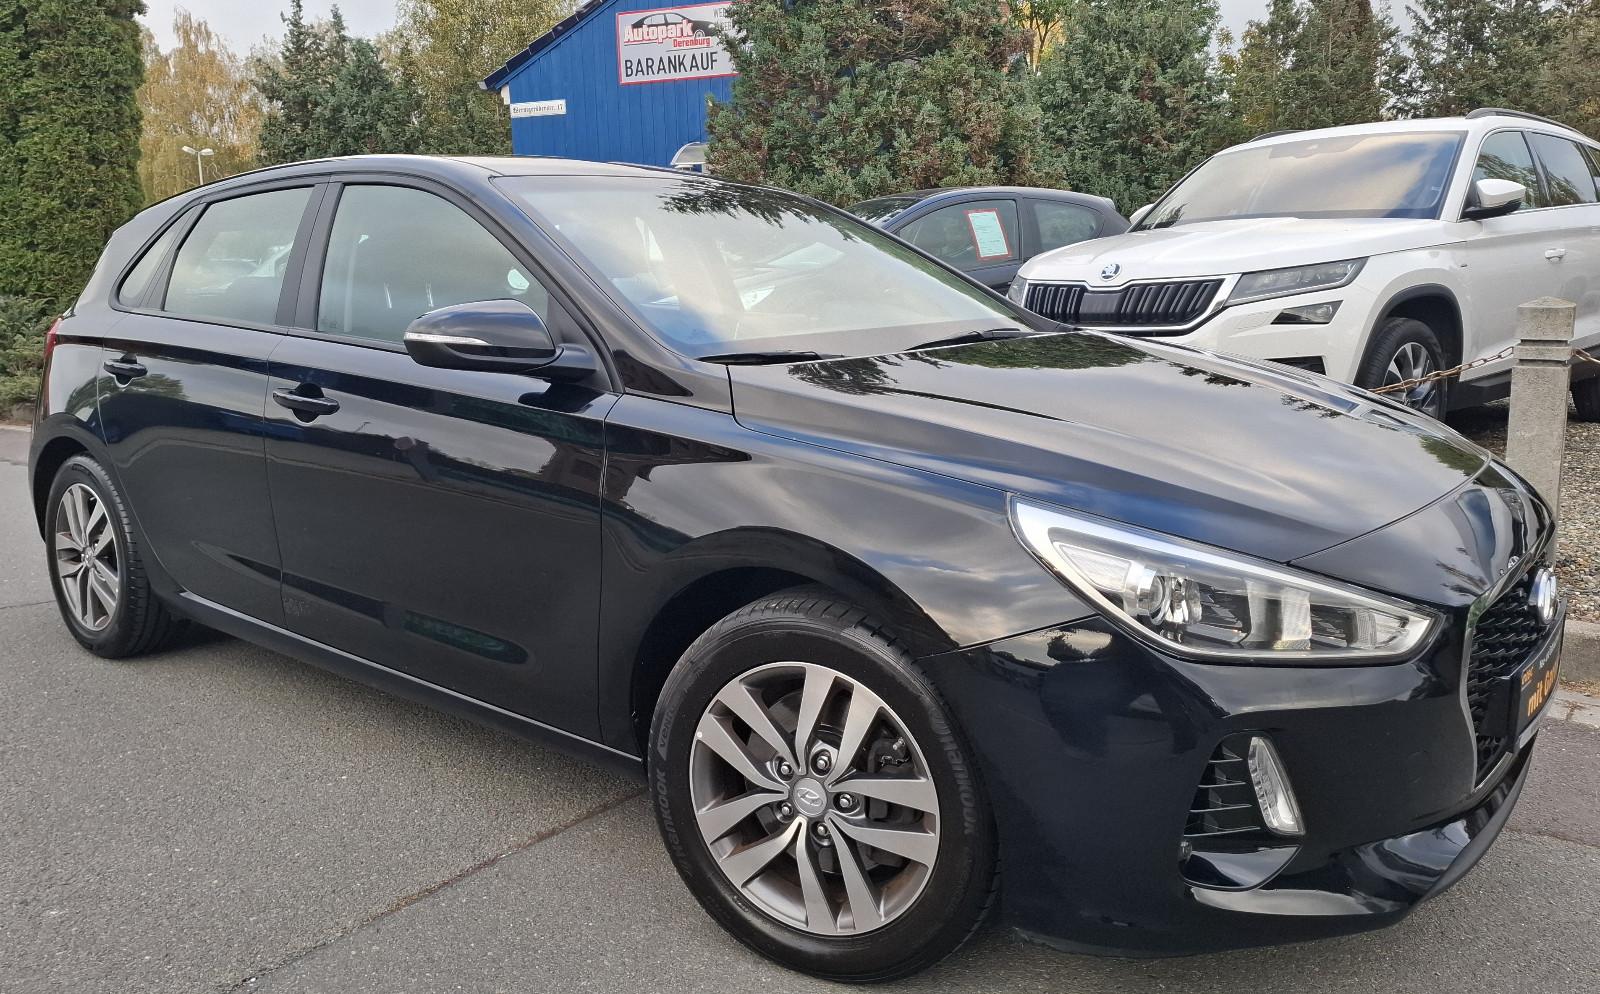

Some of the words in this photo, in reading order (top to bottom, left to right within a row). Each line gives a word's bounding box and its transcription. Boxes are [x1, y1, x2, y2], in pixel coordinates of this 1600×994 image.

[624, 19, 694, 44] Autopark
[673, 37, 711, 48] Derenburg
[624, 51, 718, 78] BARANKAUF
[1527, 679, 1543, 717] mit
